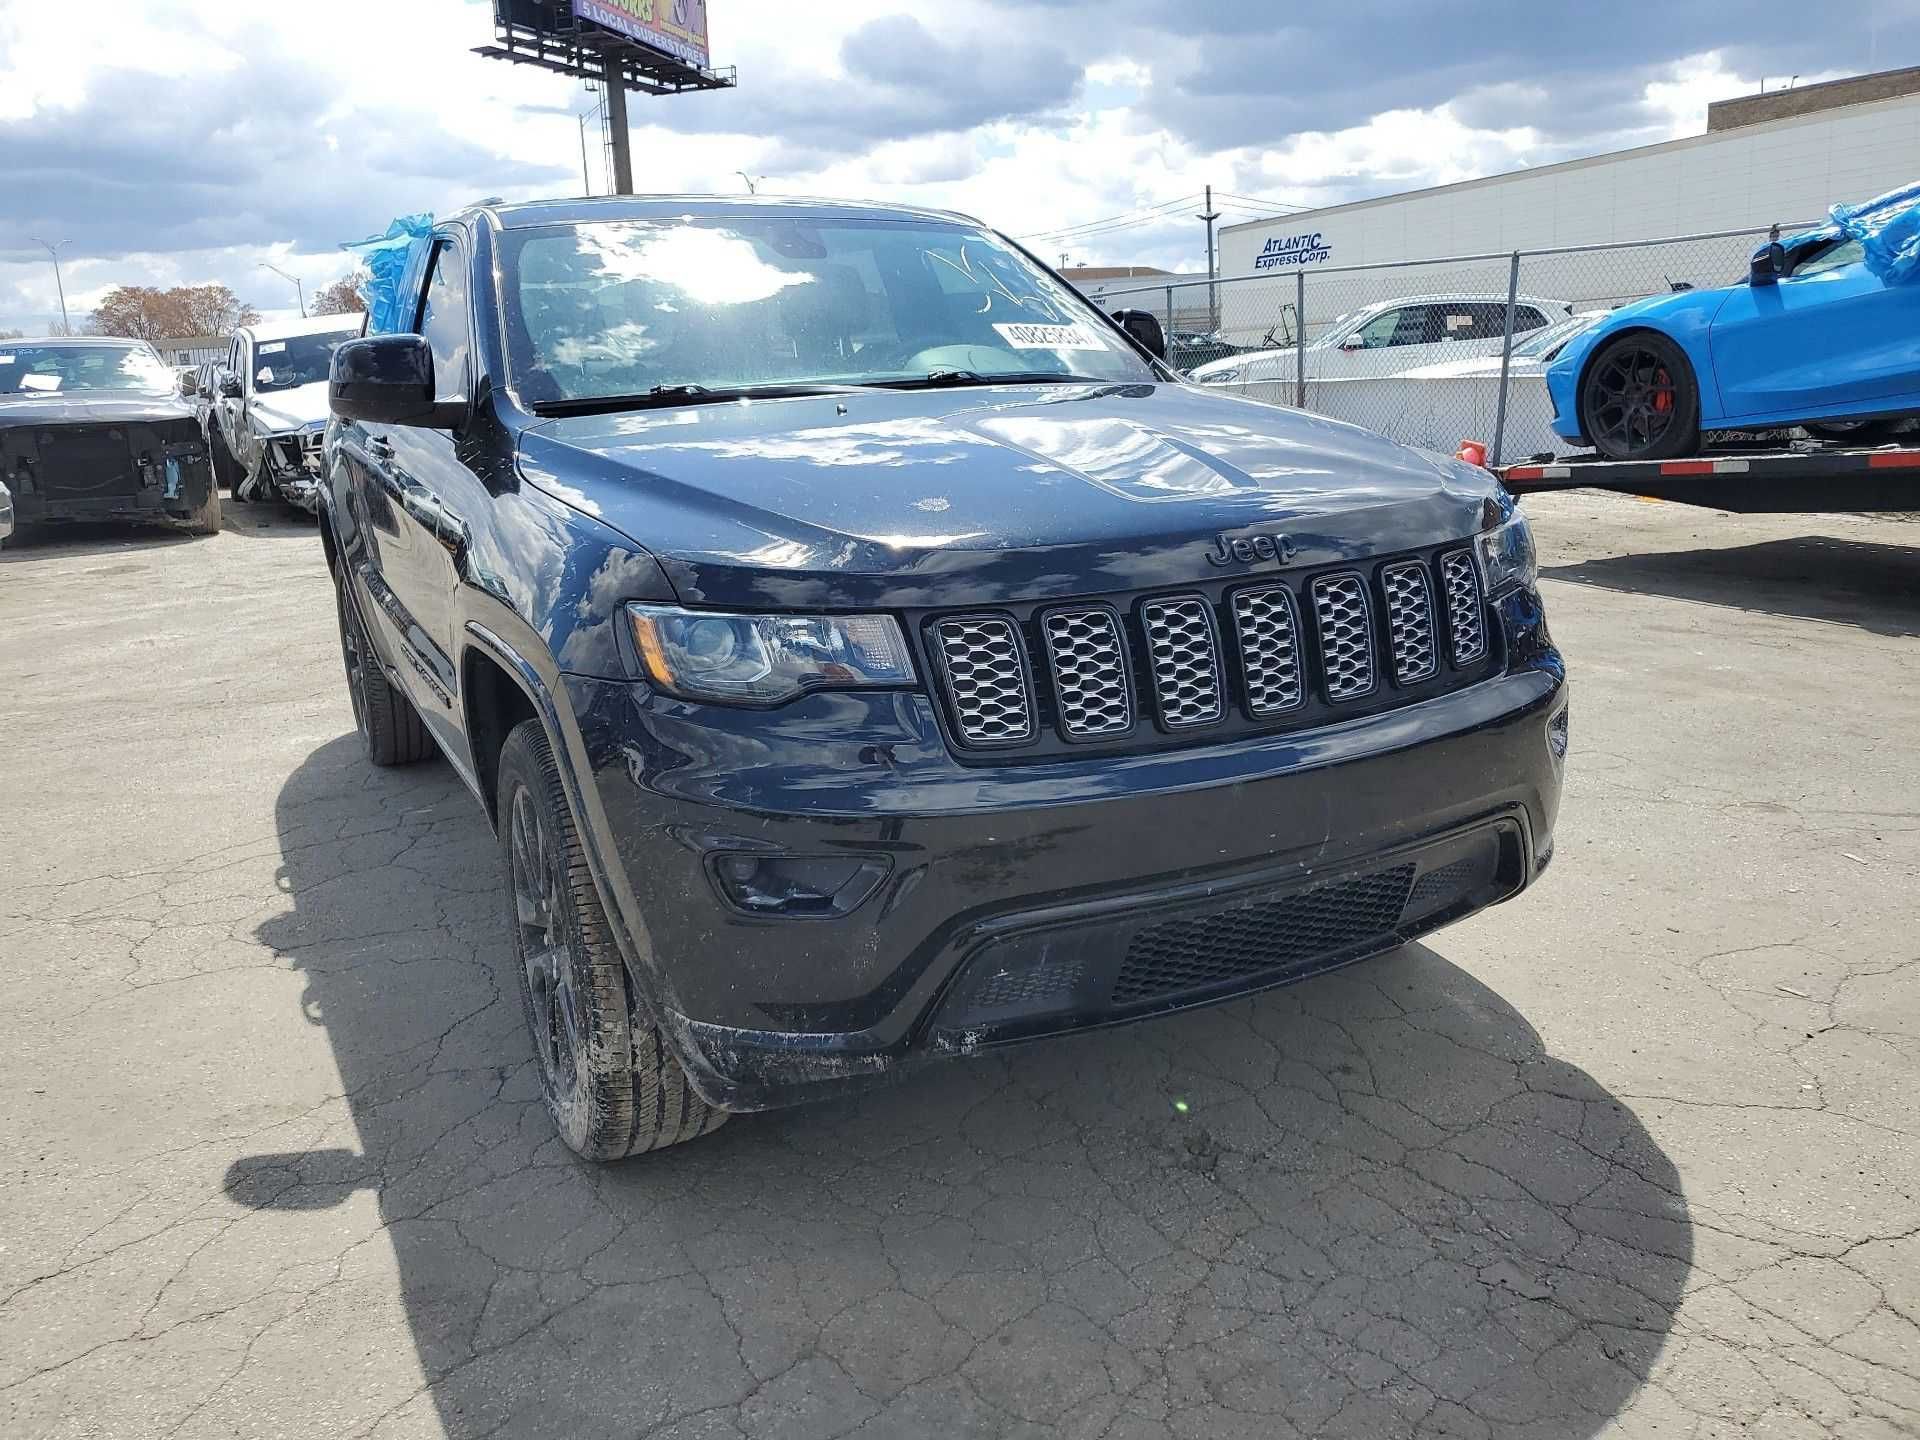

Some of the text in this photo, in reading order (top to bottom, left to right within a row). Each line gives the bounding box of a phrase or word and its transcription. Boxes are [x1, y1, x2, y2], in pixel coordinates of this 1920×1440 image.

[592, 5, 632, 37] LOCAL
[633, 24, 705, 66] SUPERSTORES
[1263, 232, 1322, 254] ATLANTIC
[1205, 533, 1297, 568] Jeep
